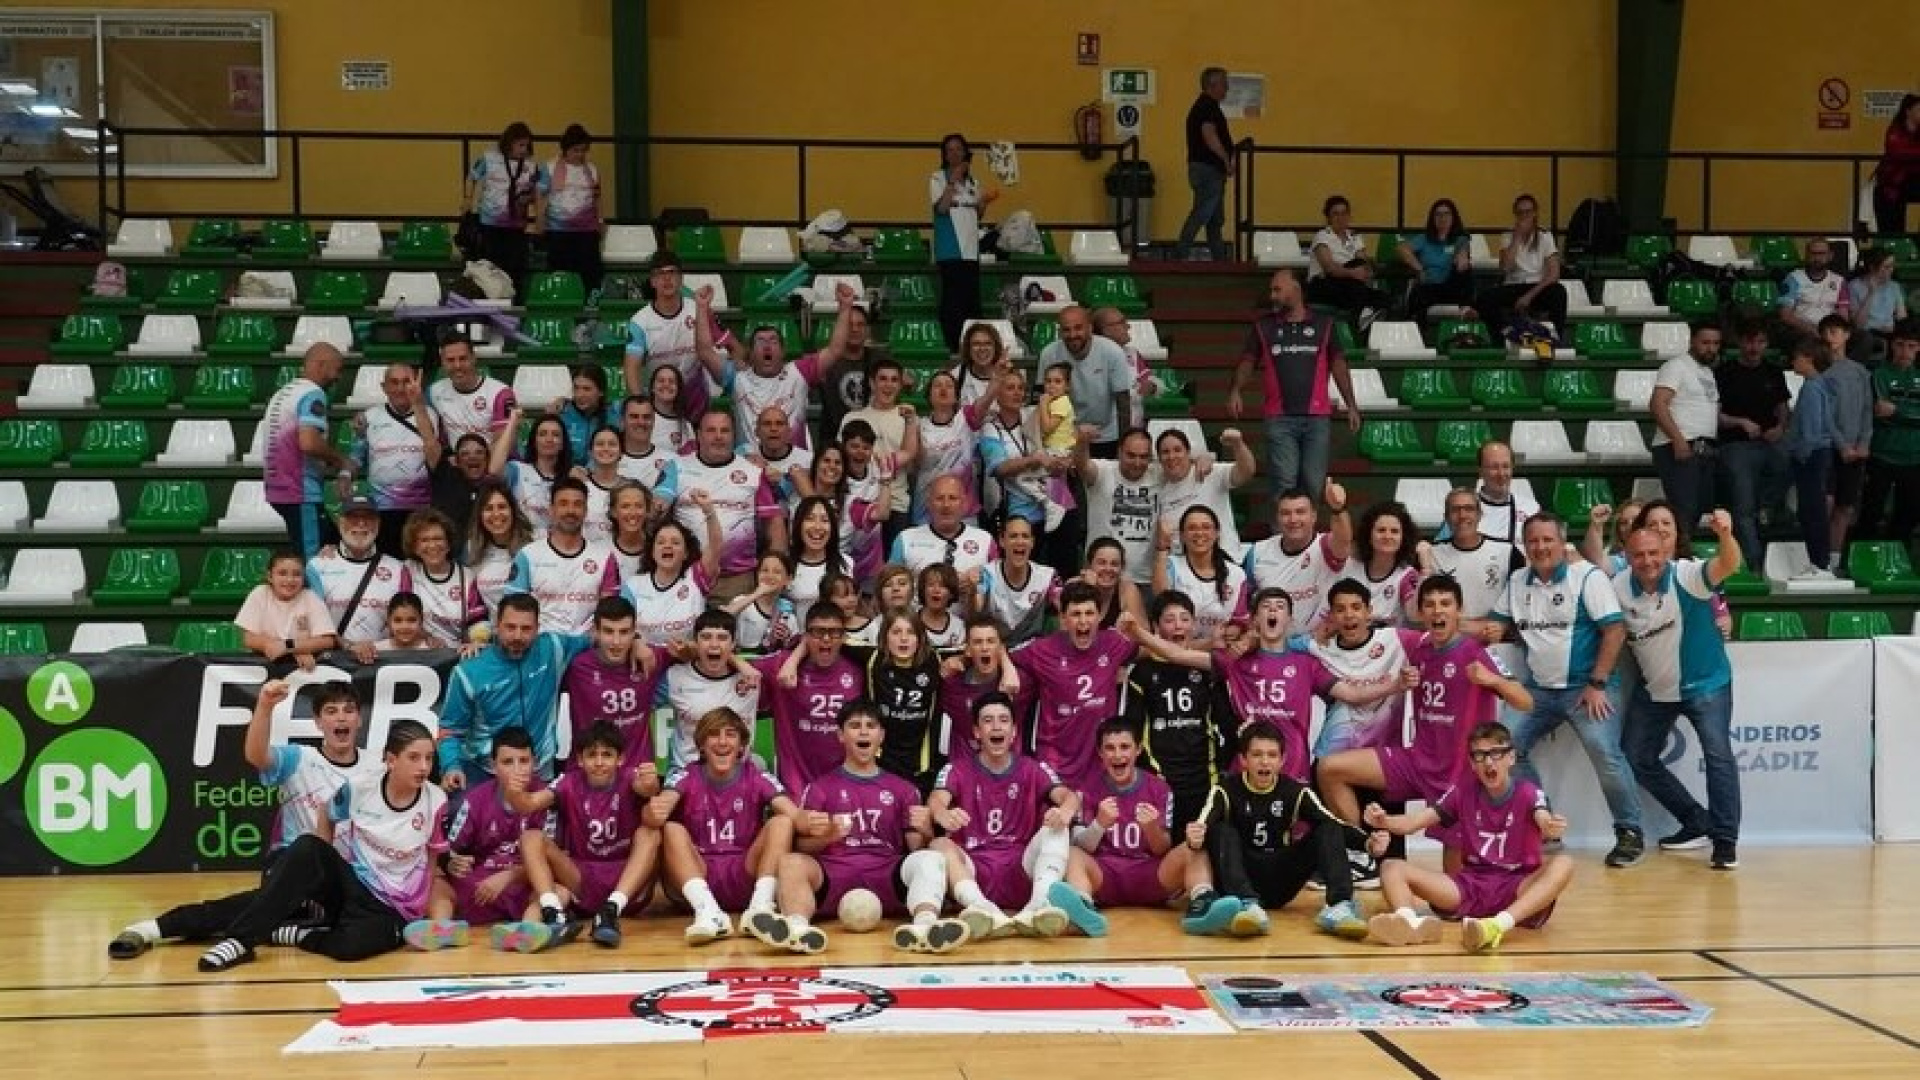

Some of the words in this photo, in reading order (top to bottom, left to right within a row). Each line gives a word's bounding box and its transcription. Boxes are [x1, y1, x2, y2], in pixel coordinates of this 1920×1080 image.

[45, 671, 80, 712] A
[894, 687, 922, 707] 12
[1076, 674, 1094, 700] 2
[1162, 687, 1194, 712] 16
[1255, 678, 1287, 703] 15
[1422, 681, 1446, 707] 32
[601, 688, 637, 714] 38
[809, 694, 844, 718] 25
[38, 762, 153, 833] BM
[587, 817, 618, 844] 20
[706, 818, 735, 844] 14
[853, 809, 882, 831] 17
[987, 809, 1003, 834] 8
[196, 810, 262, 858] de
[1108, 822, 1141, 849] 10
[1253, 822, 1268, 846] 5
[1478, 831, 1509, 858] 71
